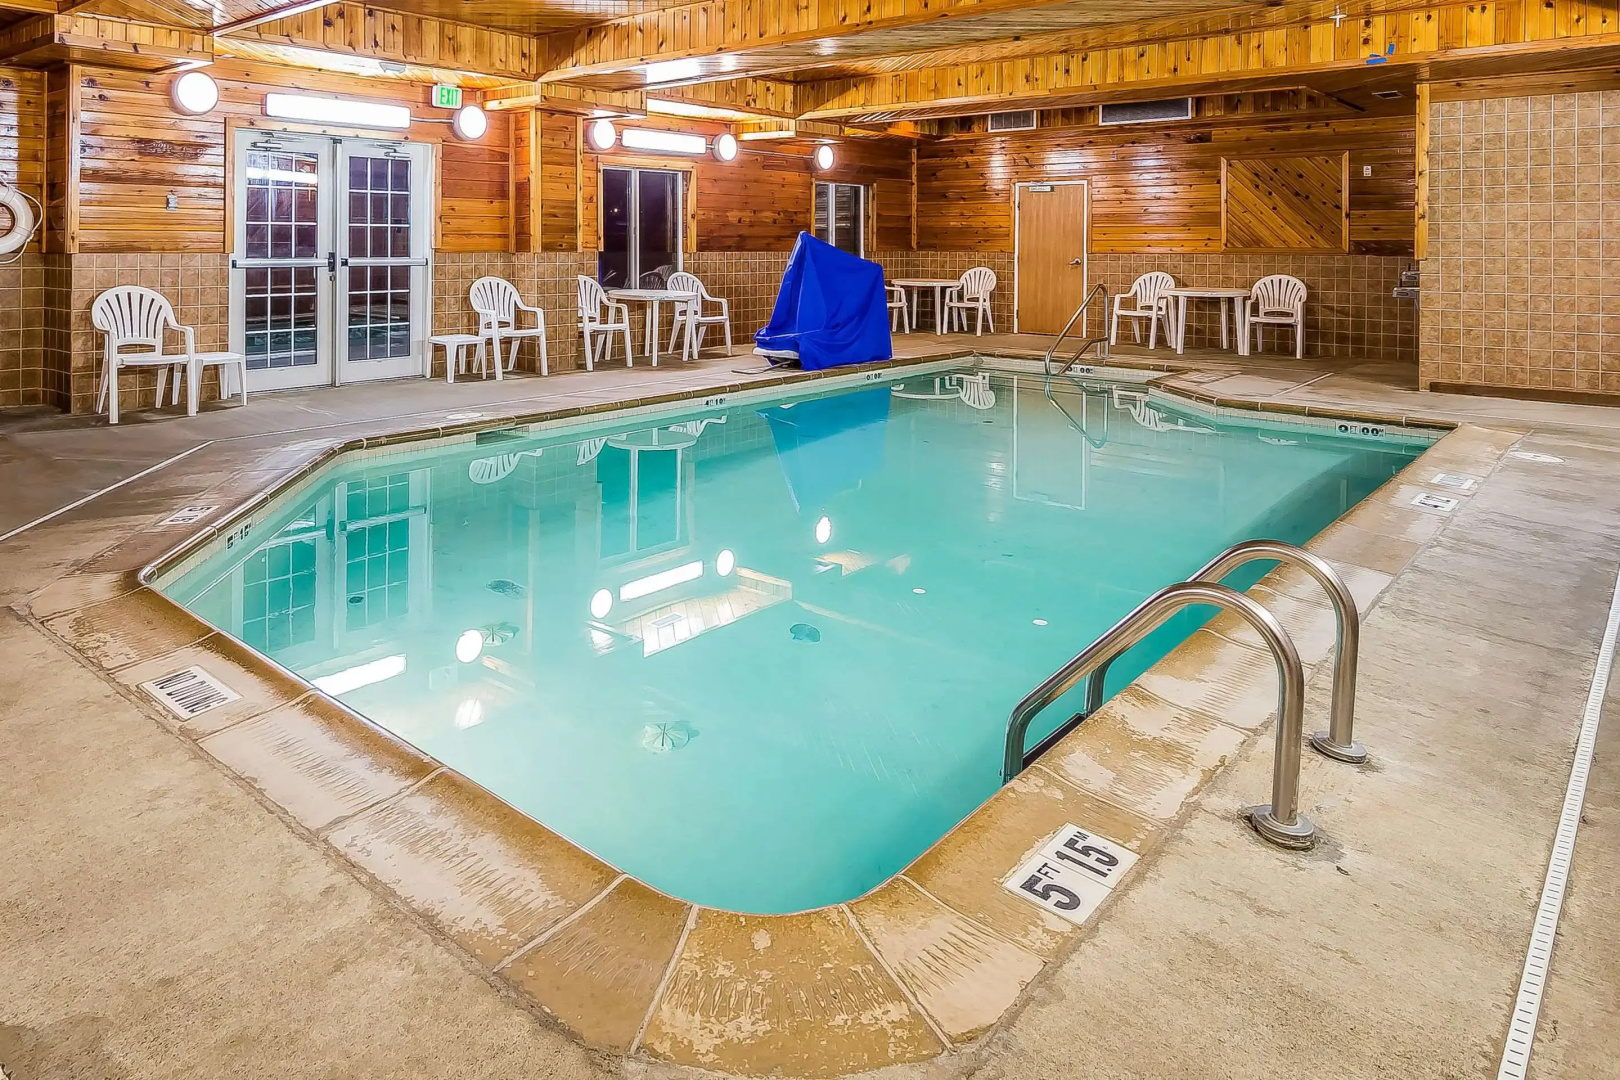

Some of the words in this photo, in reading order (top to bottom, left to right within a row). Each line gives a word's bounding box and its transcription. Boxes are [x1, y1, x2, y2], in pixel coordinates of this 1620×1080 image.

[440, 87, 459, 106] EXIT
[152, 670, 198, 690] NO
[166, 680, 229, 714] DIVING
[1037, 862, 1061, 880] FT
[1019, 874, 1081, 911] 5
